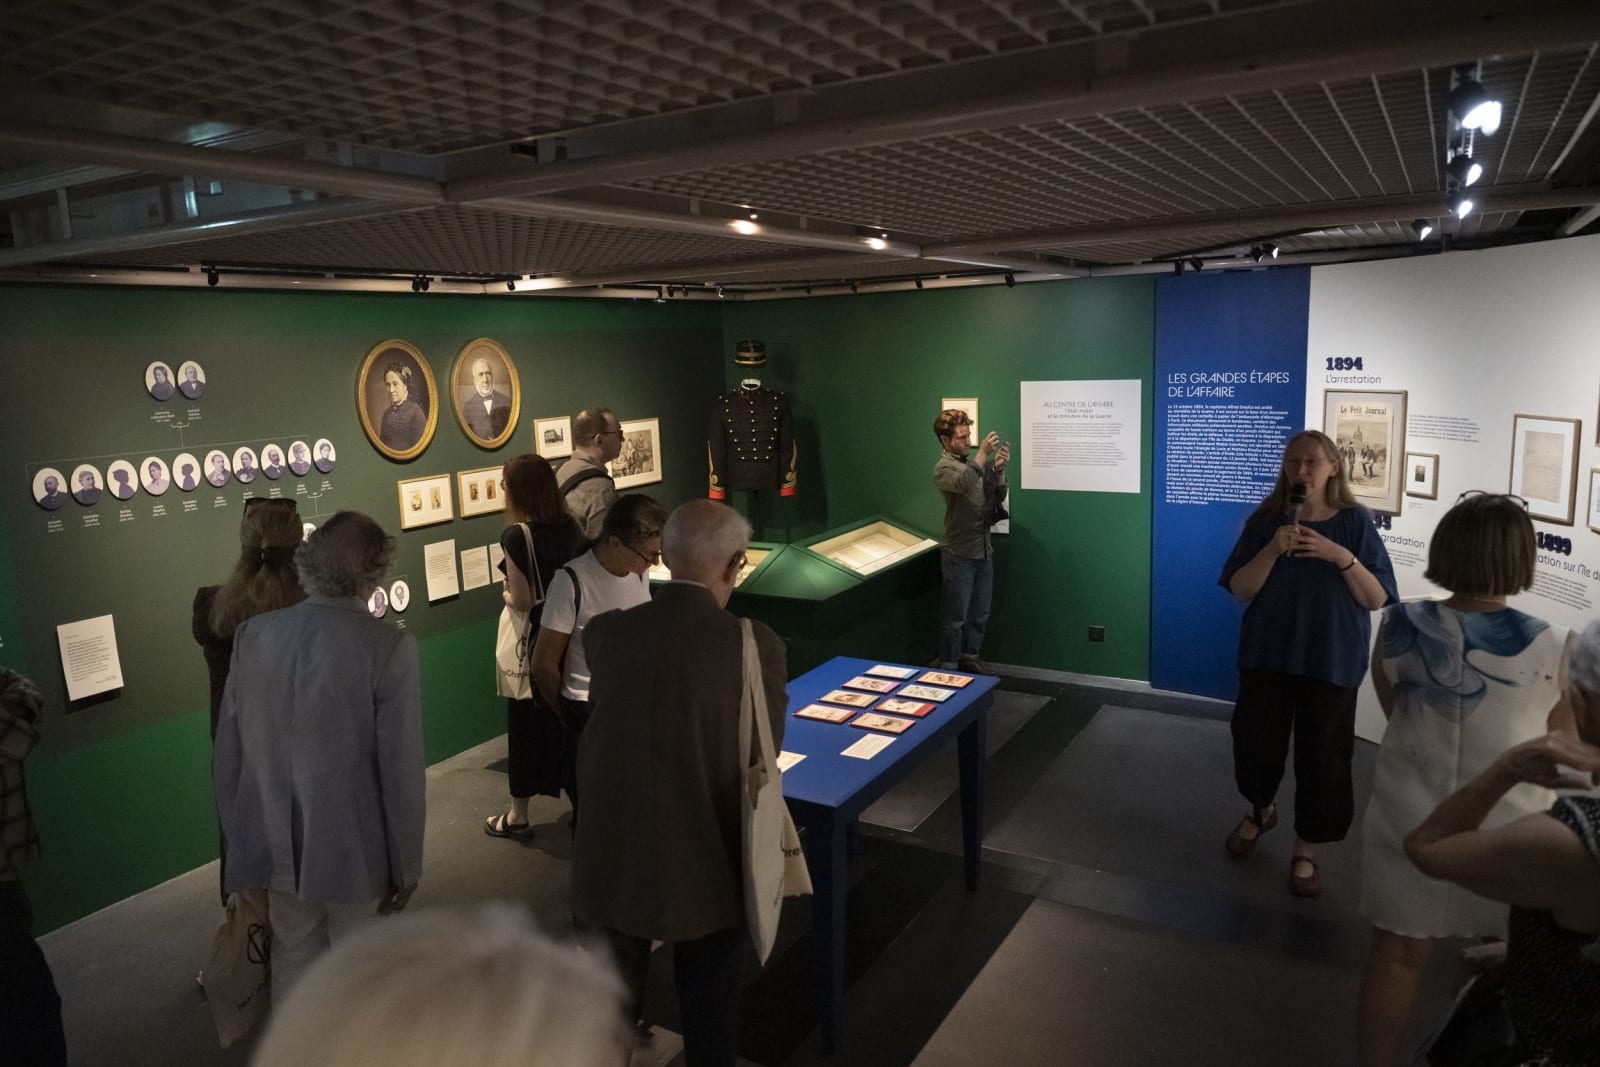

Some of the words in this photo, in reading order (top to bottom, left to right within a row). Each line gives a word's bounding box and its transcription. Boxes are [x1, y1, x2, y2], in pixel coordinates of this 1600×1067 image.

[1325, 356, 1363, 371] 1894
[1168, 373, 1187, 384] LES
[1190, 372, 1247, 384] GRANDES
[1250, 370, 1290, 384] ÉTAPES
[1325, 374, 1381, 384] L'arrestation
[1168, 386, 1186, 398] DE
[1186, 386, 1235, 398] L'AFFAIRE
[1365, 406, 1387, 415] Journal
[1536, 532, 1572, 556] 1899
[1535, 554, 1562, 568] ation
[1563, 562, 1576, 573] sur
